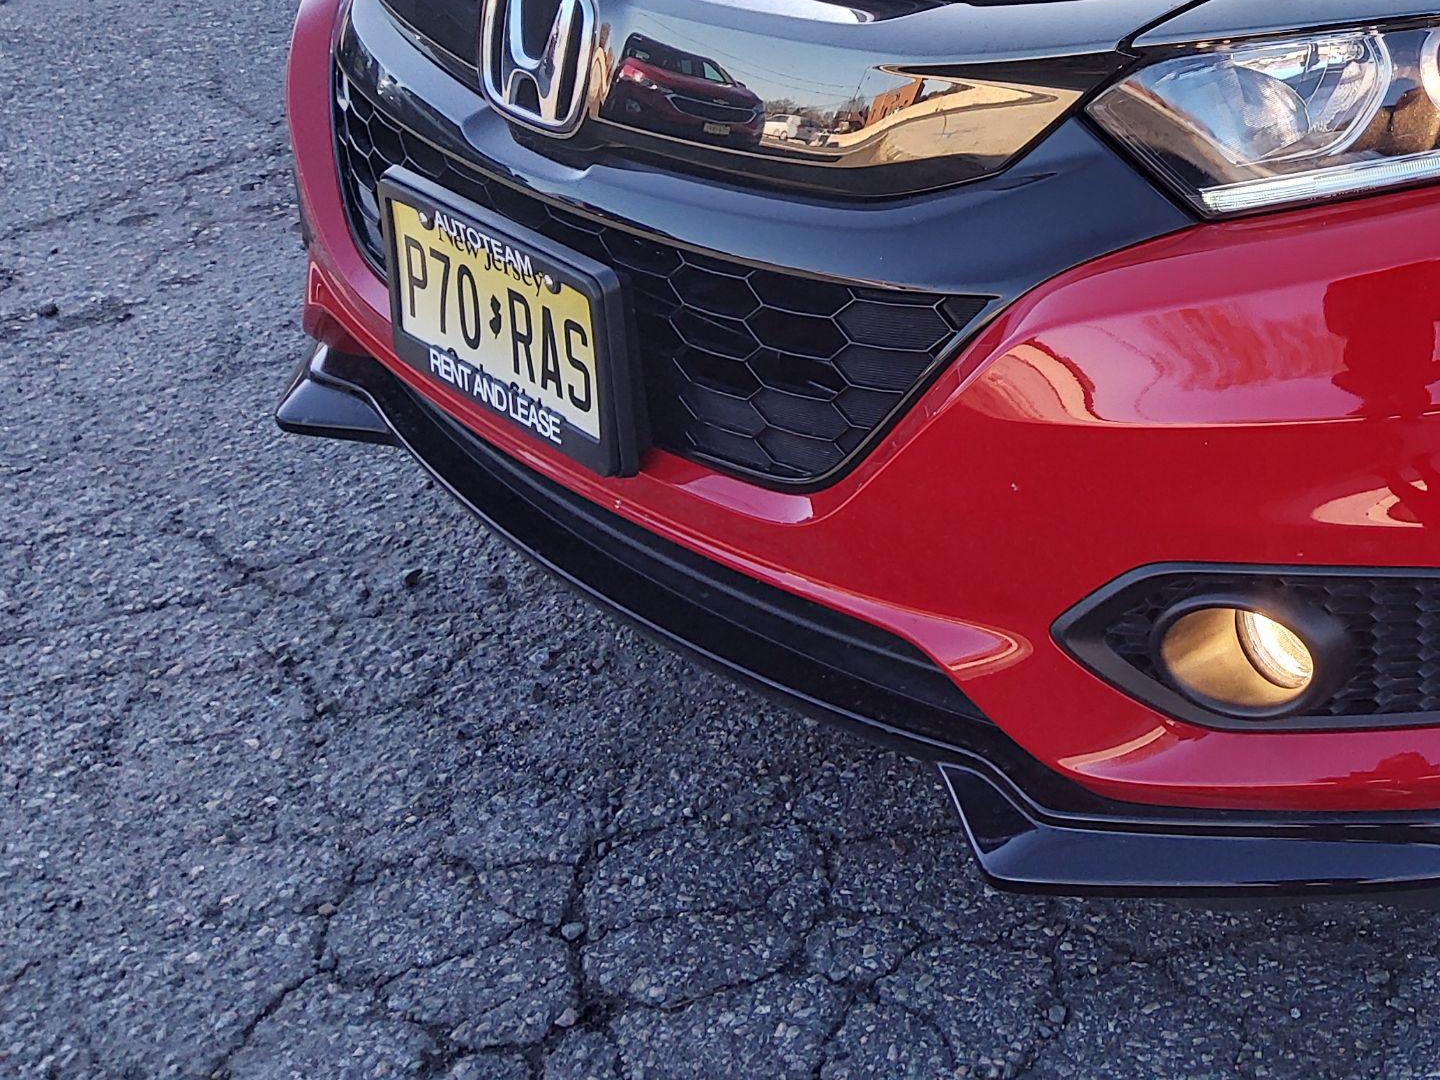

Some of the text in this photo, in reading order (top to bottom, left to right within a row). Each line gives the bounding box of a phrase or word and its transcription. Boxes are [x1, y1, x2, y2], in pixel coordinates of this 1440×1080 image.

[434, 210, 533, 275] AUTOTEAM
[429, 348, 471, 392] RENT
[473, 374, 507, 412] AND
[508, 392, 562, 445] LEASE
